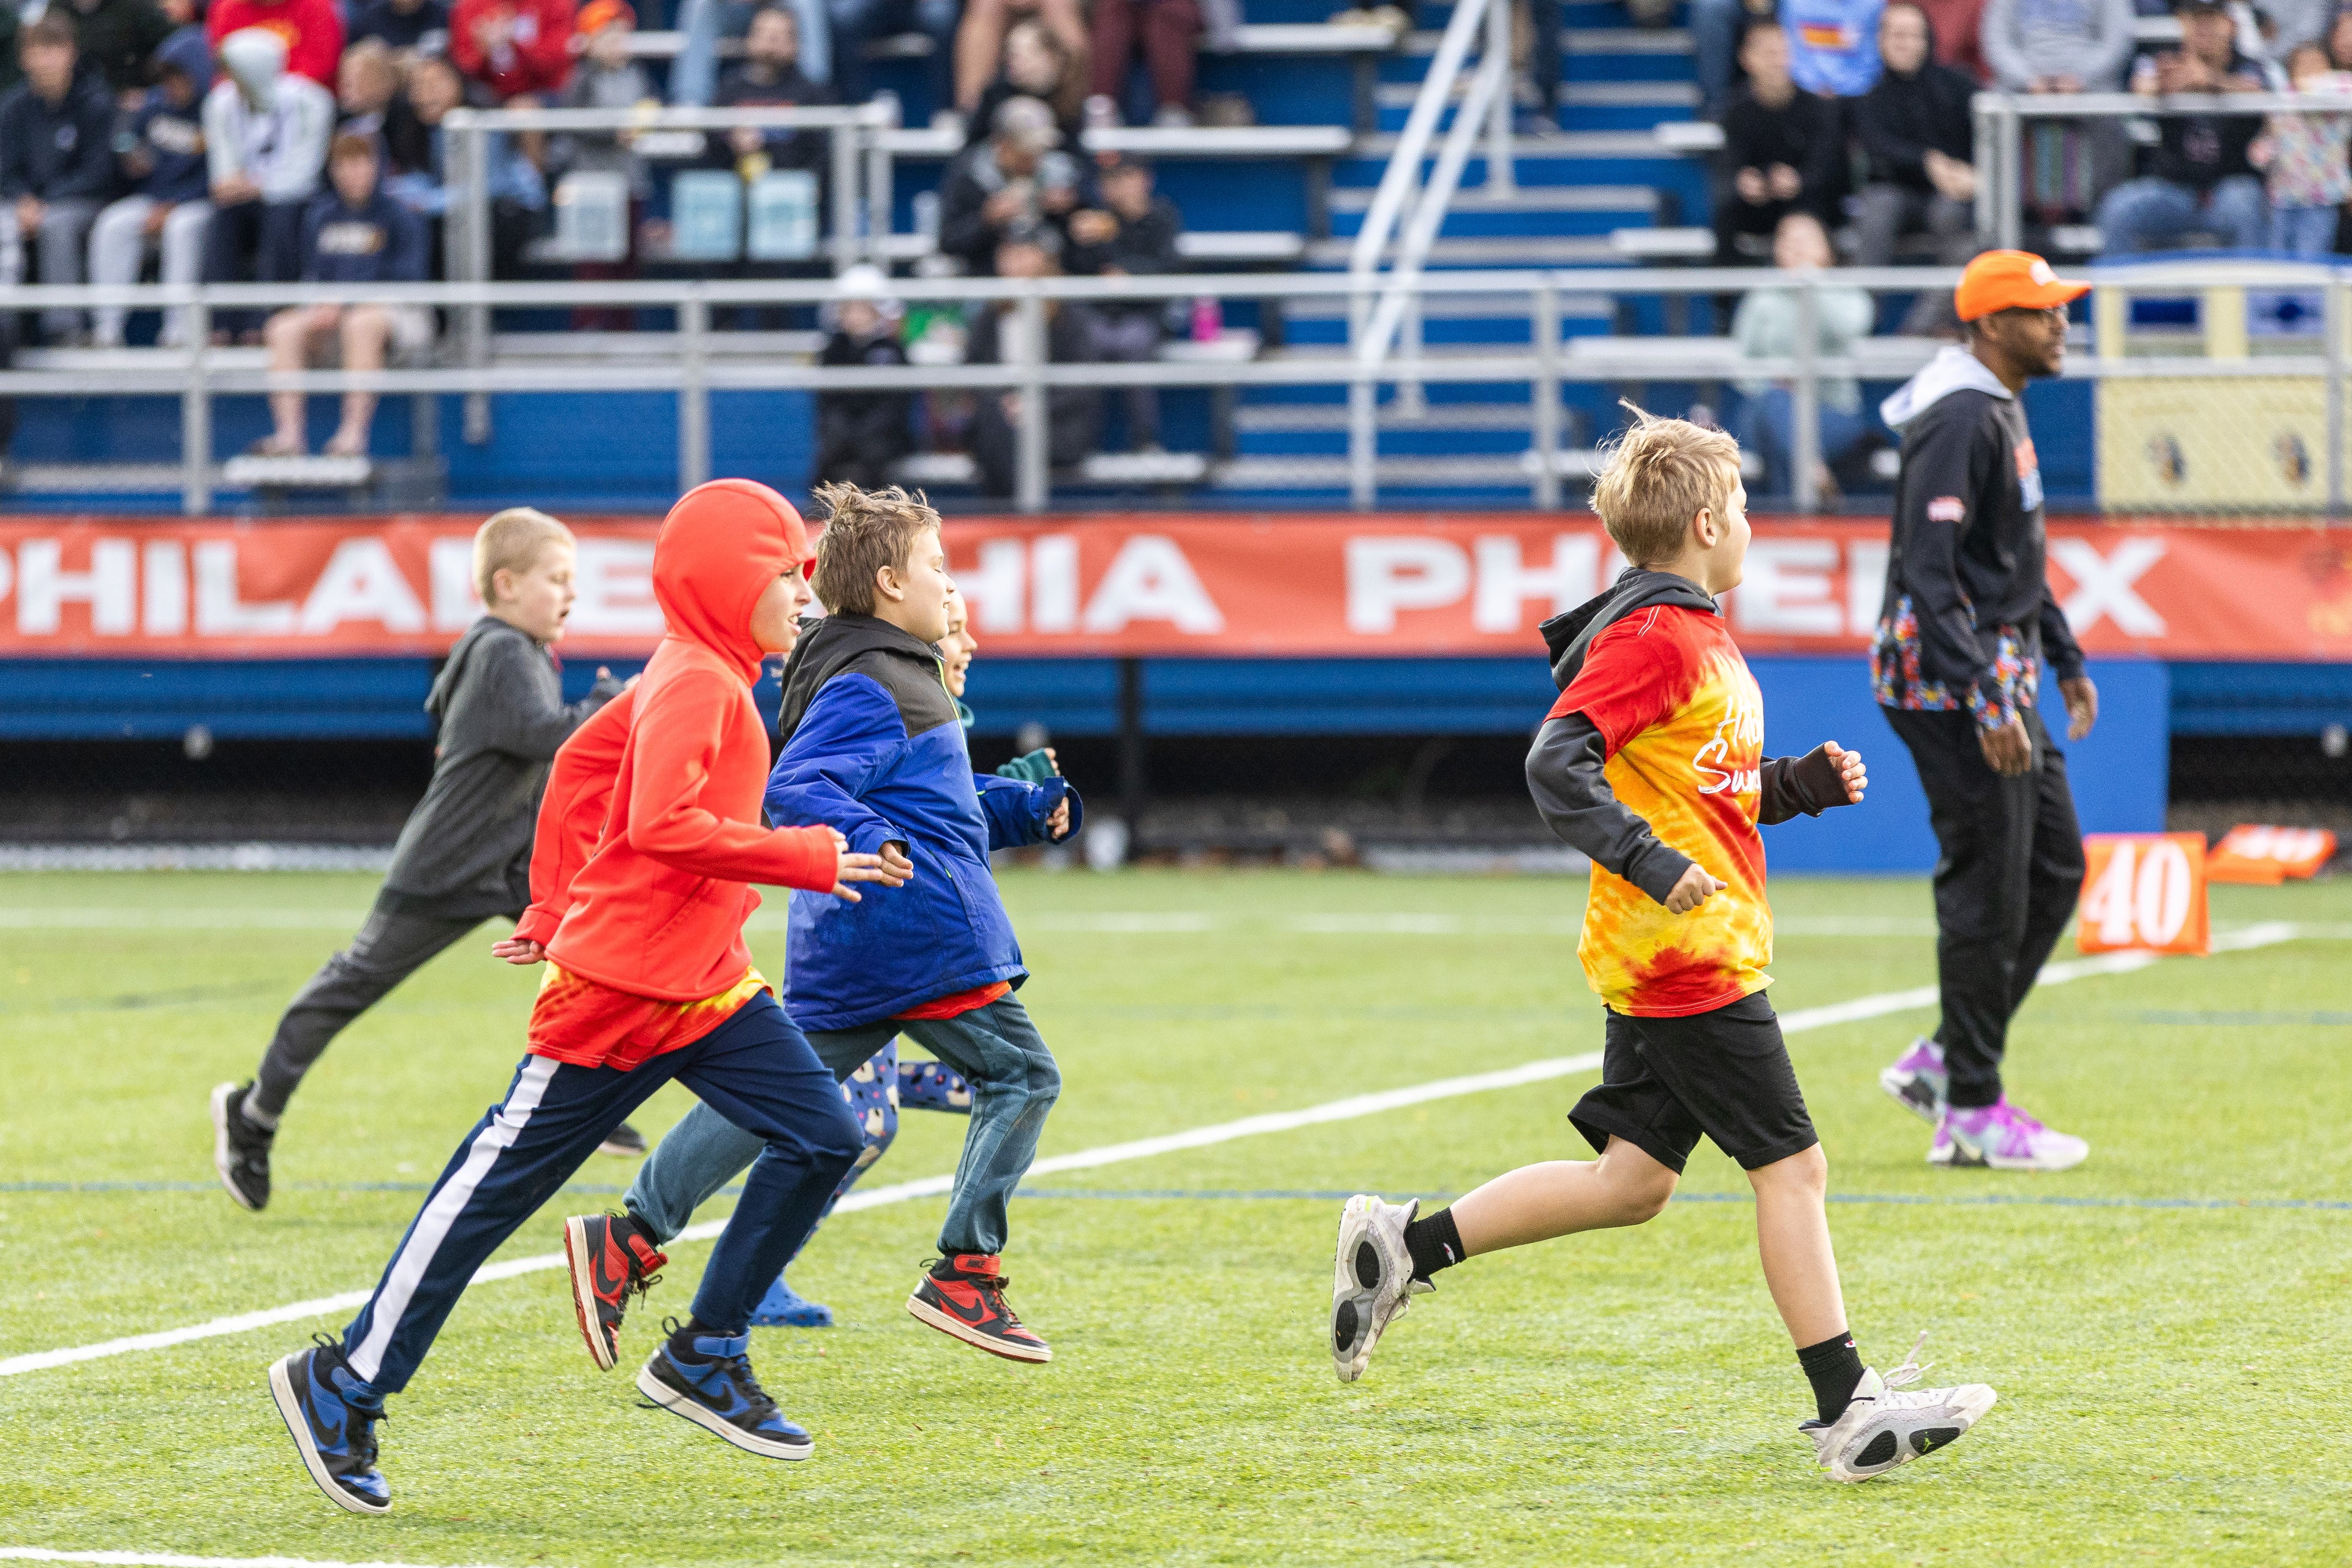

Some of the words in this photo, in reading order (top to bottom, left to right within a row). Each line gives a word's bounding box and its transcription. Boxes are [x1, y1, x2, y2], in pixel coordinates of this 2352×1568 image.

[0, 536, 1224, 637] HILAEHIA
[1346, 534, 2168, 638] PHEX
[2084, 840, 2191, 946] 40
